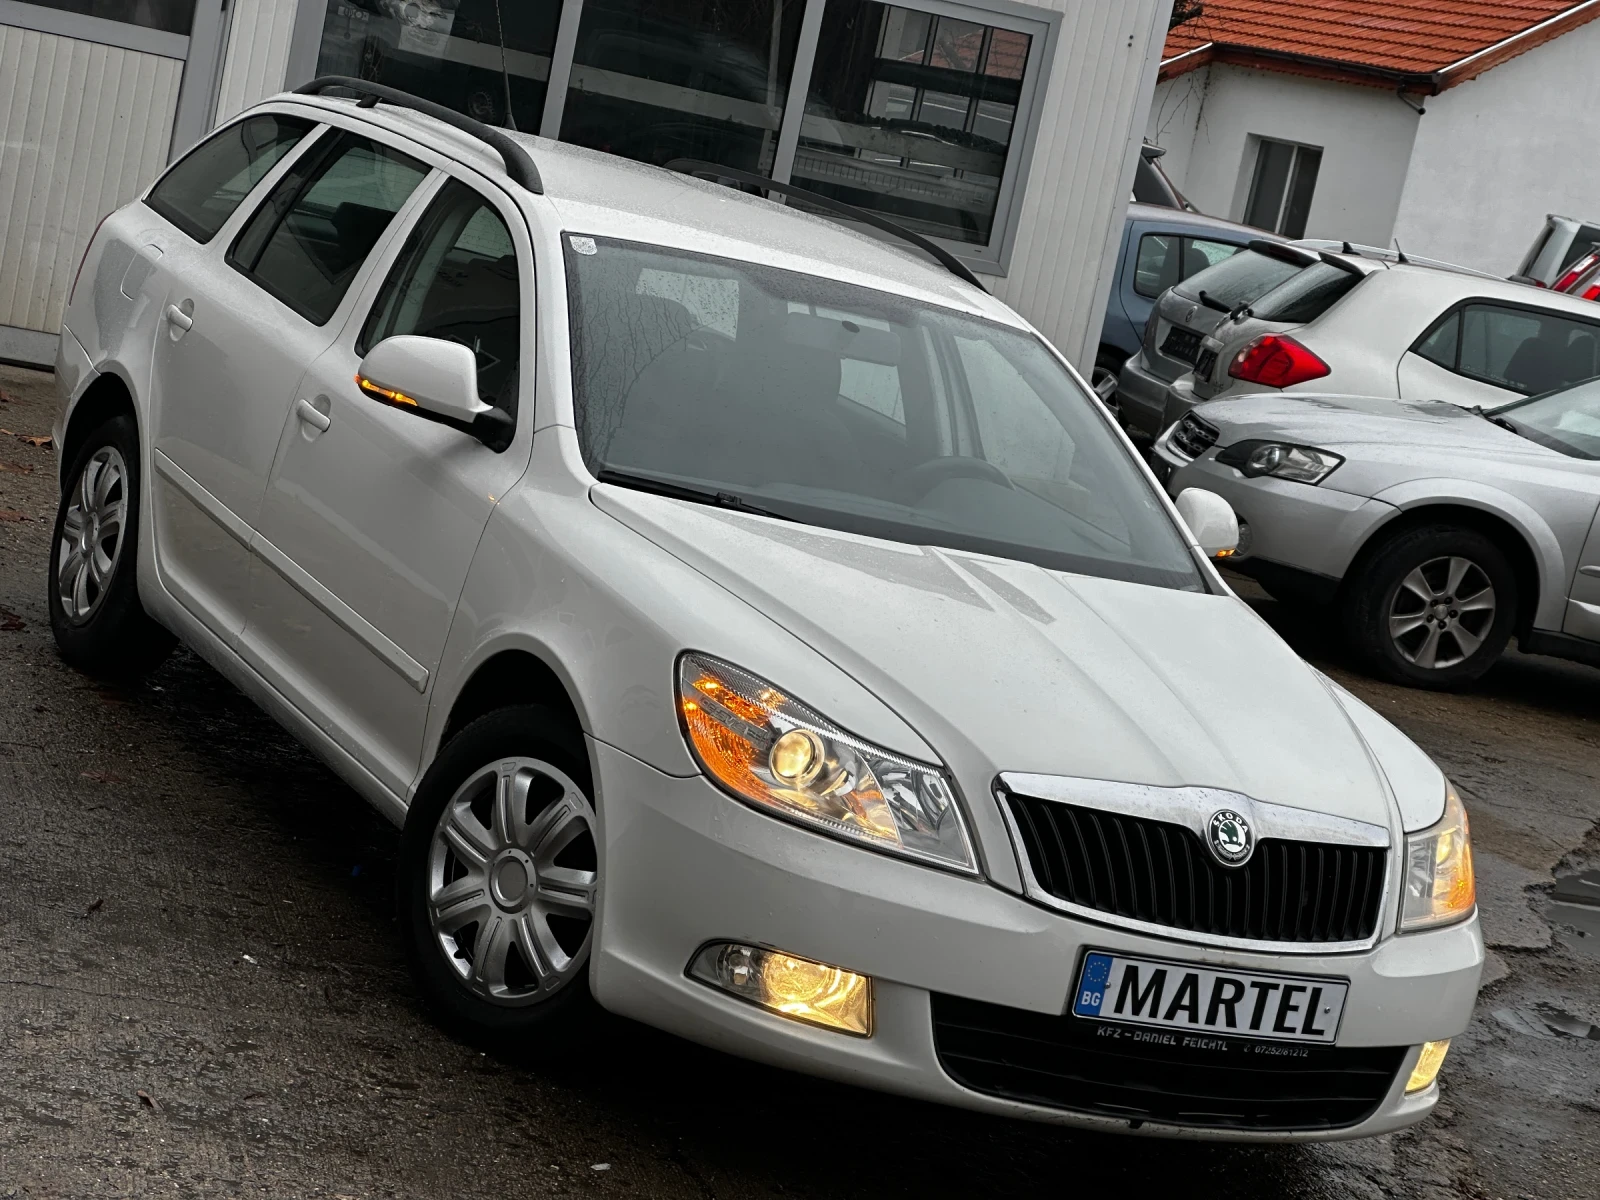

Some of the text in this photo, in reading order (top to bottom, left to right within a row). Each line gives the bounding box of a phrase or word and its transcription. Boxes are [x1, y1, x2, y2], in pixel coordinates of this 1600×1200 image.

[1081, 991, 1101, 1007] BG
[1113, 964, 1325, 1036] MARTEL
[1182, 1036, 1228, 1051] FEICHTL
